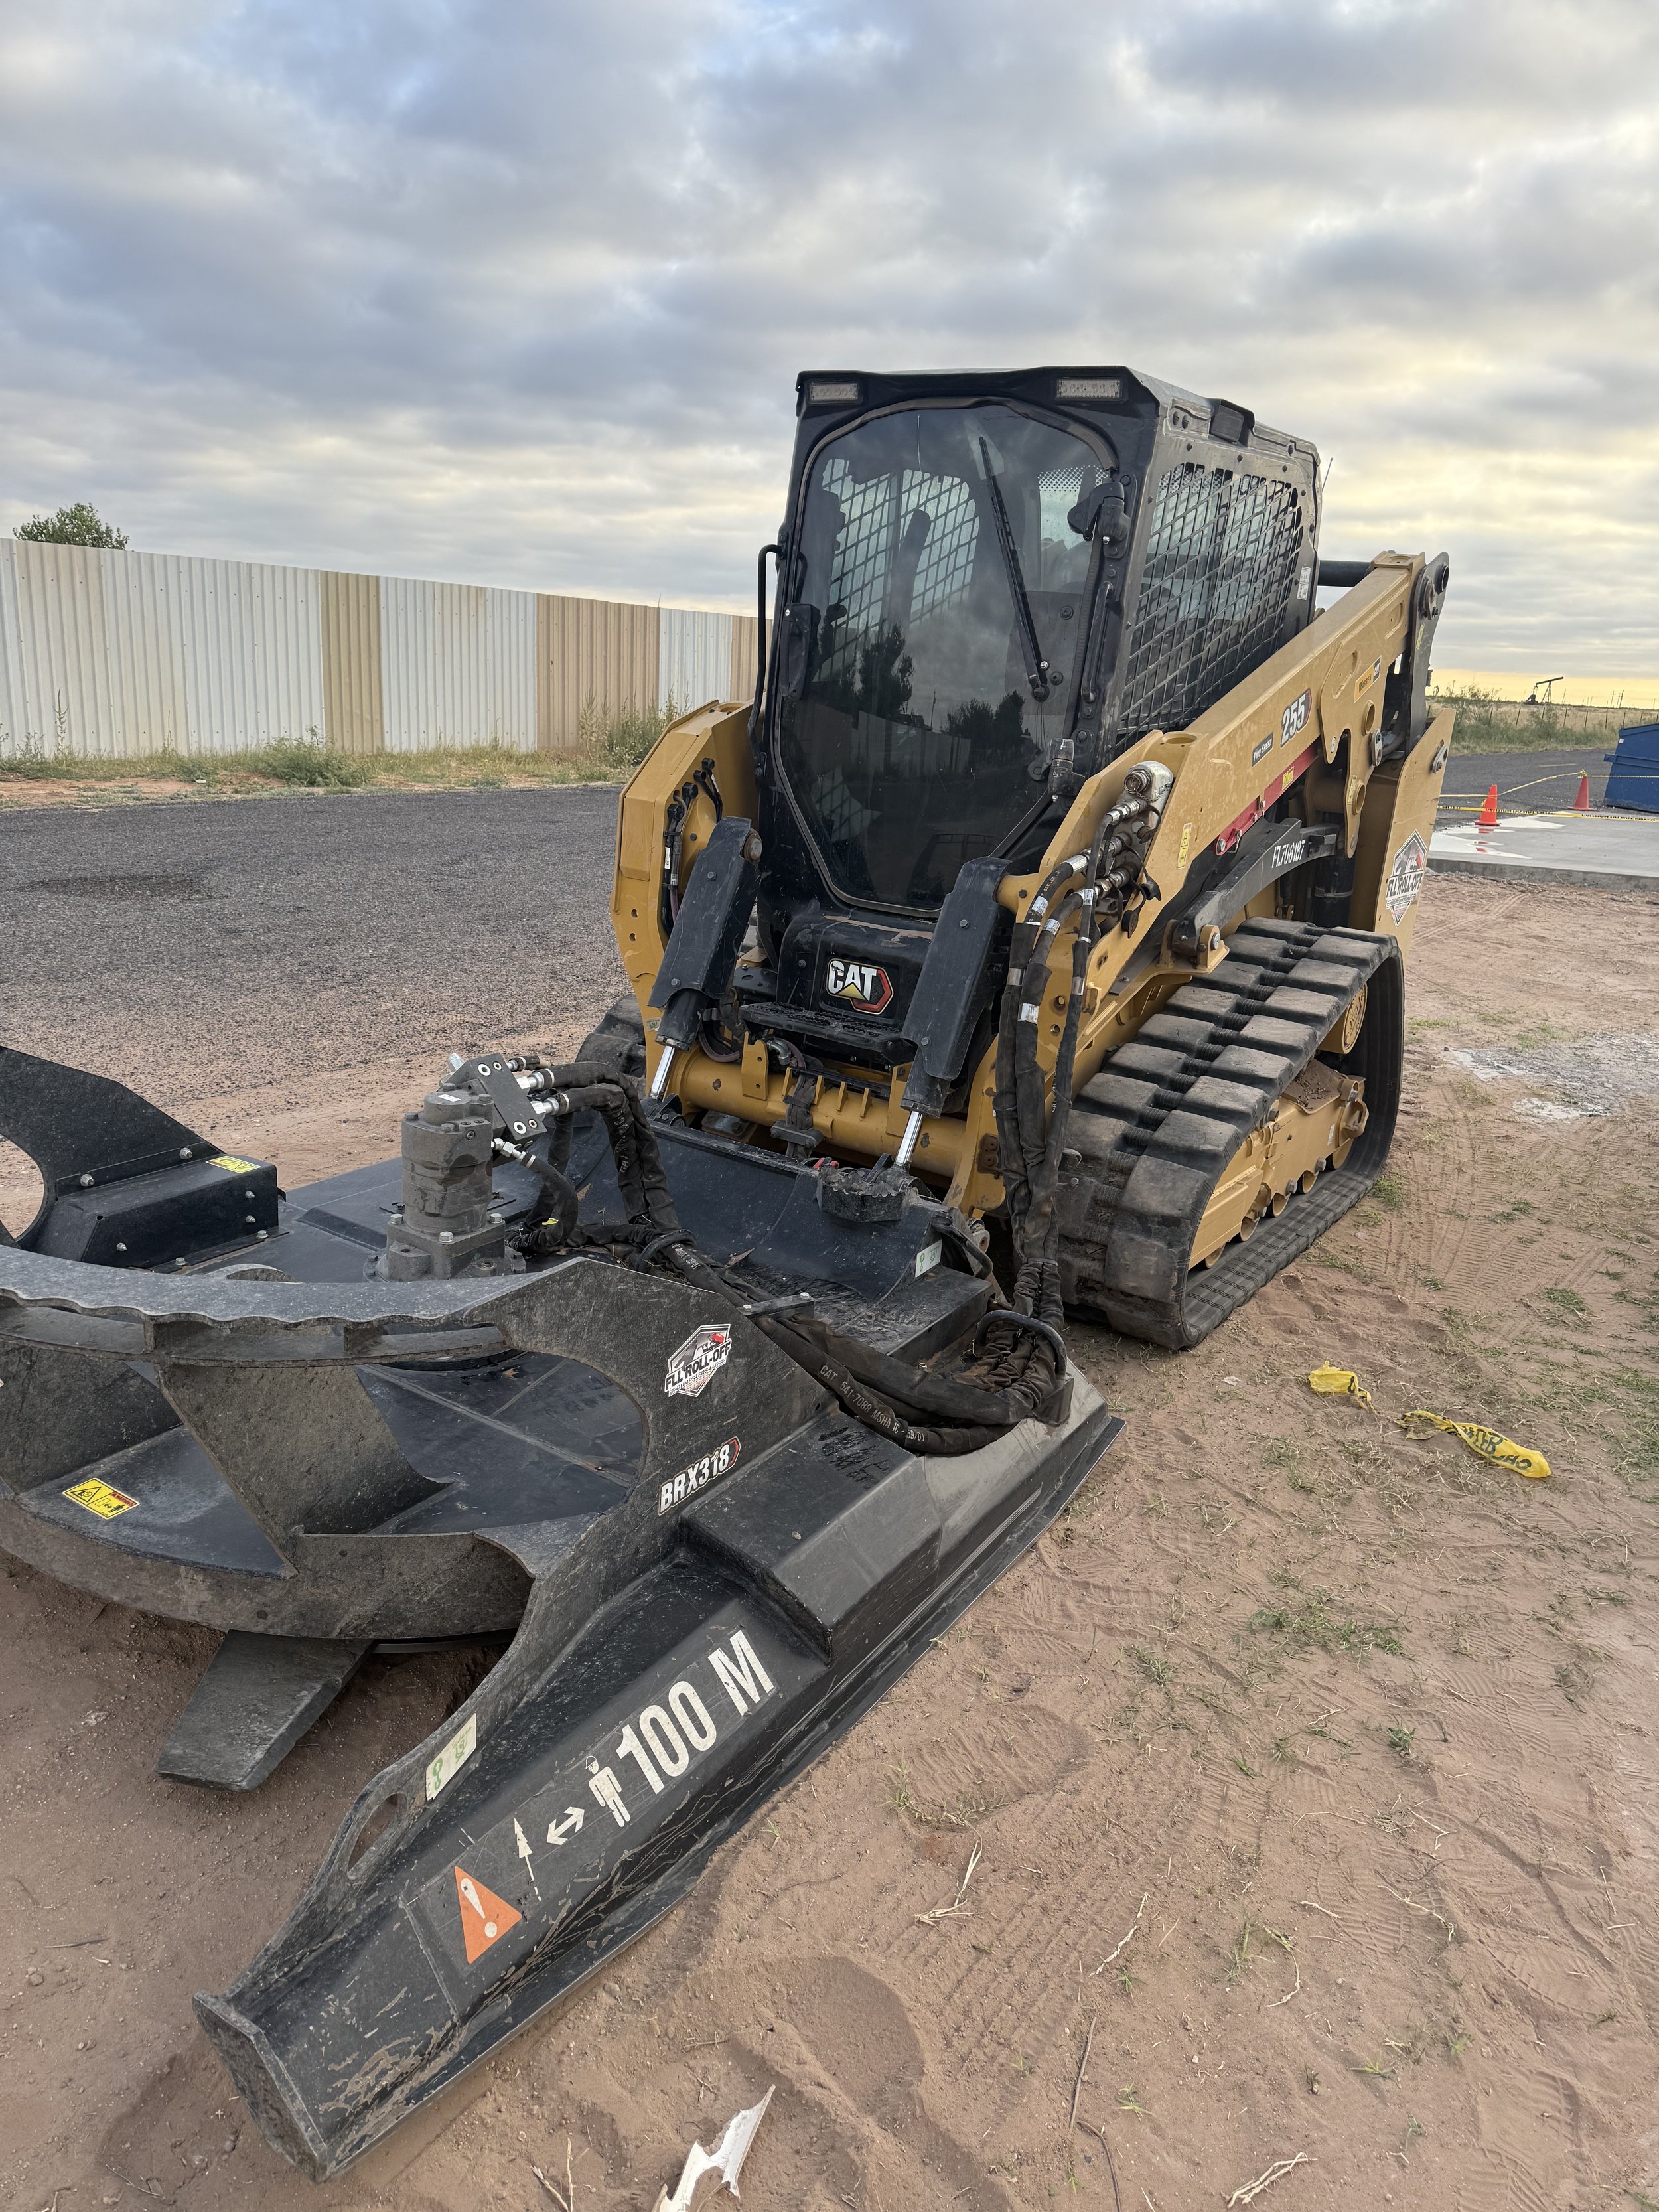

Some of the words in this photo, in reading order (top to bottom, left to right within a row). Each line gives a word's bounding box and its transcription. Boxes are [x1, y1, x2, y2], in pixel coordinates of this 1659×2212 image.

[1281, 694, 1306, 745] 255
[1271, 839, 1306, 869] FL708187
[1386, 878, 1398, 898] FLL
[828, 960, 877, 1001] CAT
[666, 1370, 684, 1390] FLL
[685, 1341, 731, 1379] ROLL-OFF
[820, 1364, 838, 1381] CAT
[840, 1380, 872, 1413] 541-7088
[871, 1409, 891, 1428] MSHA
[660, 1443, 730, 1512] BRX318
[616, 1680, 717, 1795] 100
[707, 1629, 774, 1716] M
